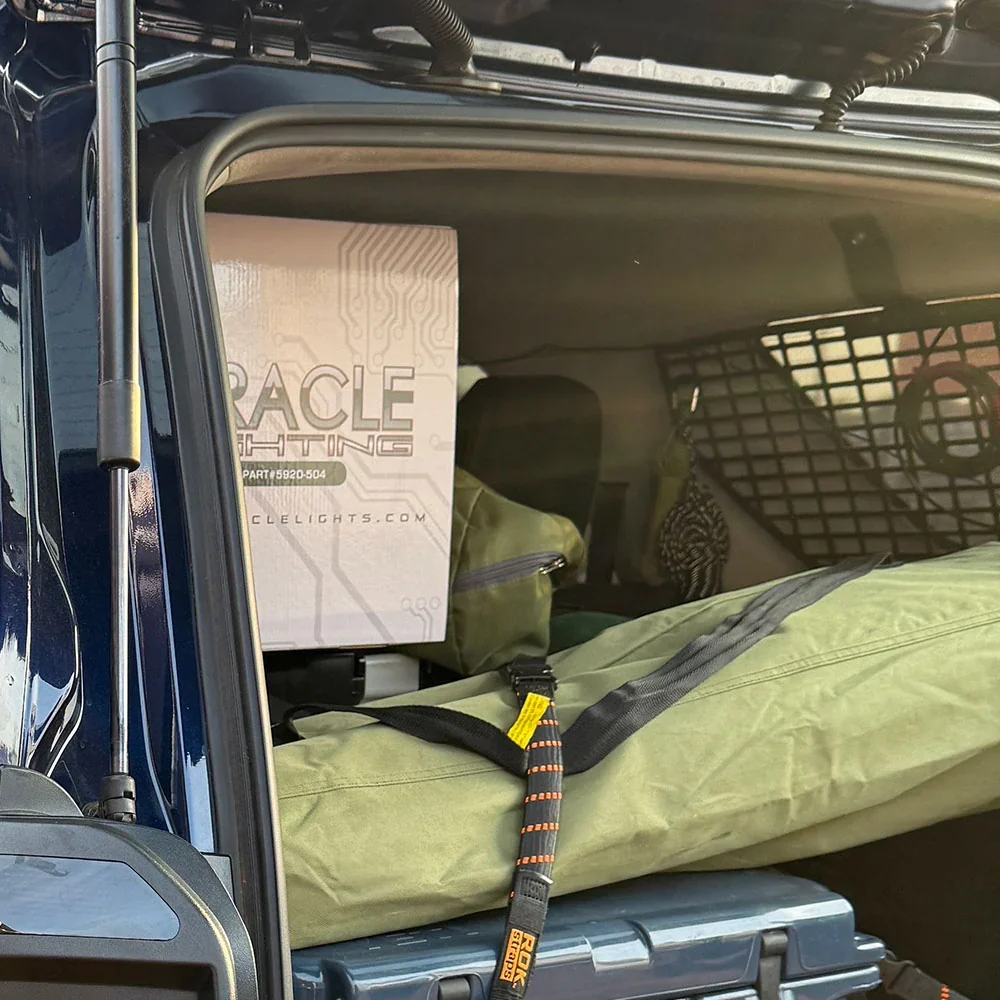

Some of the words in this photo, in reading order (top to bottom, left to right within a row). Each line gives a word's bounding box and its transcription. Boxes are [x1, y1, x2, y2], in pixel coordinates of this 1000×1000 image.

[242, 468, 327, 480] PART#5920-504
[251, 512, 427, 526] CLELIGHTS.COM
[503, 931, 521, 979] straps
[513, 932, 536, 987] ROK
